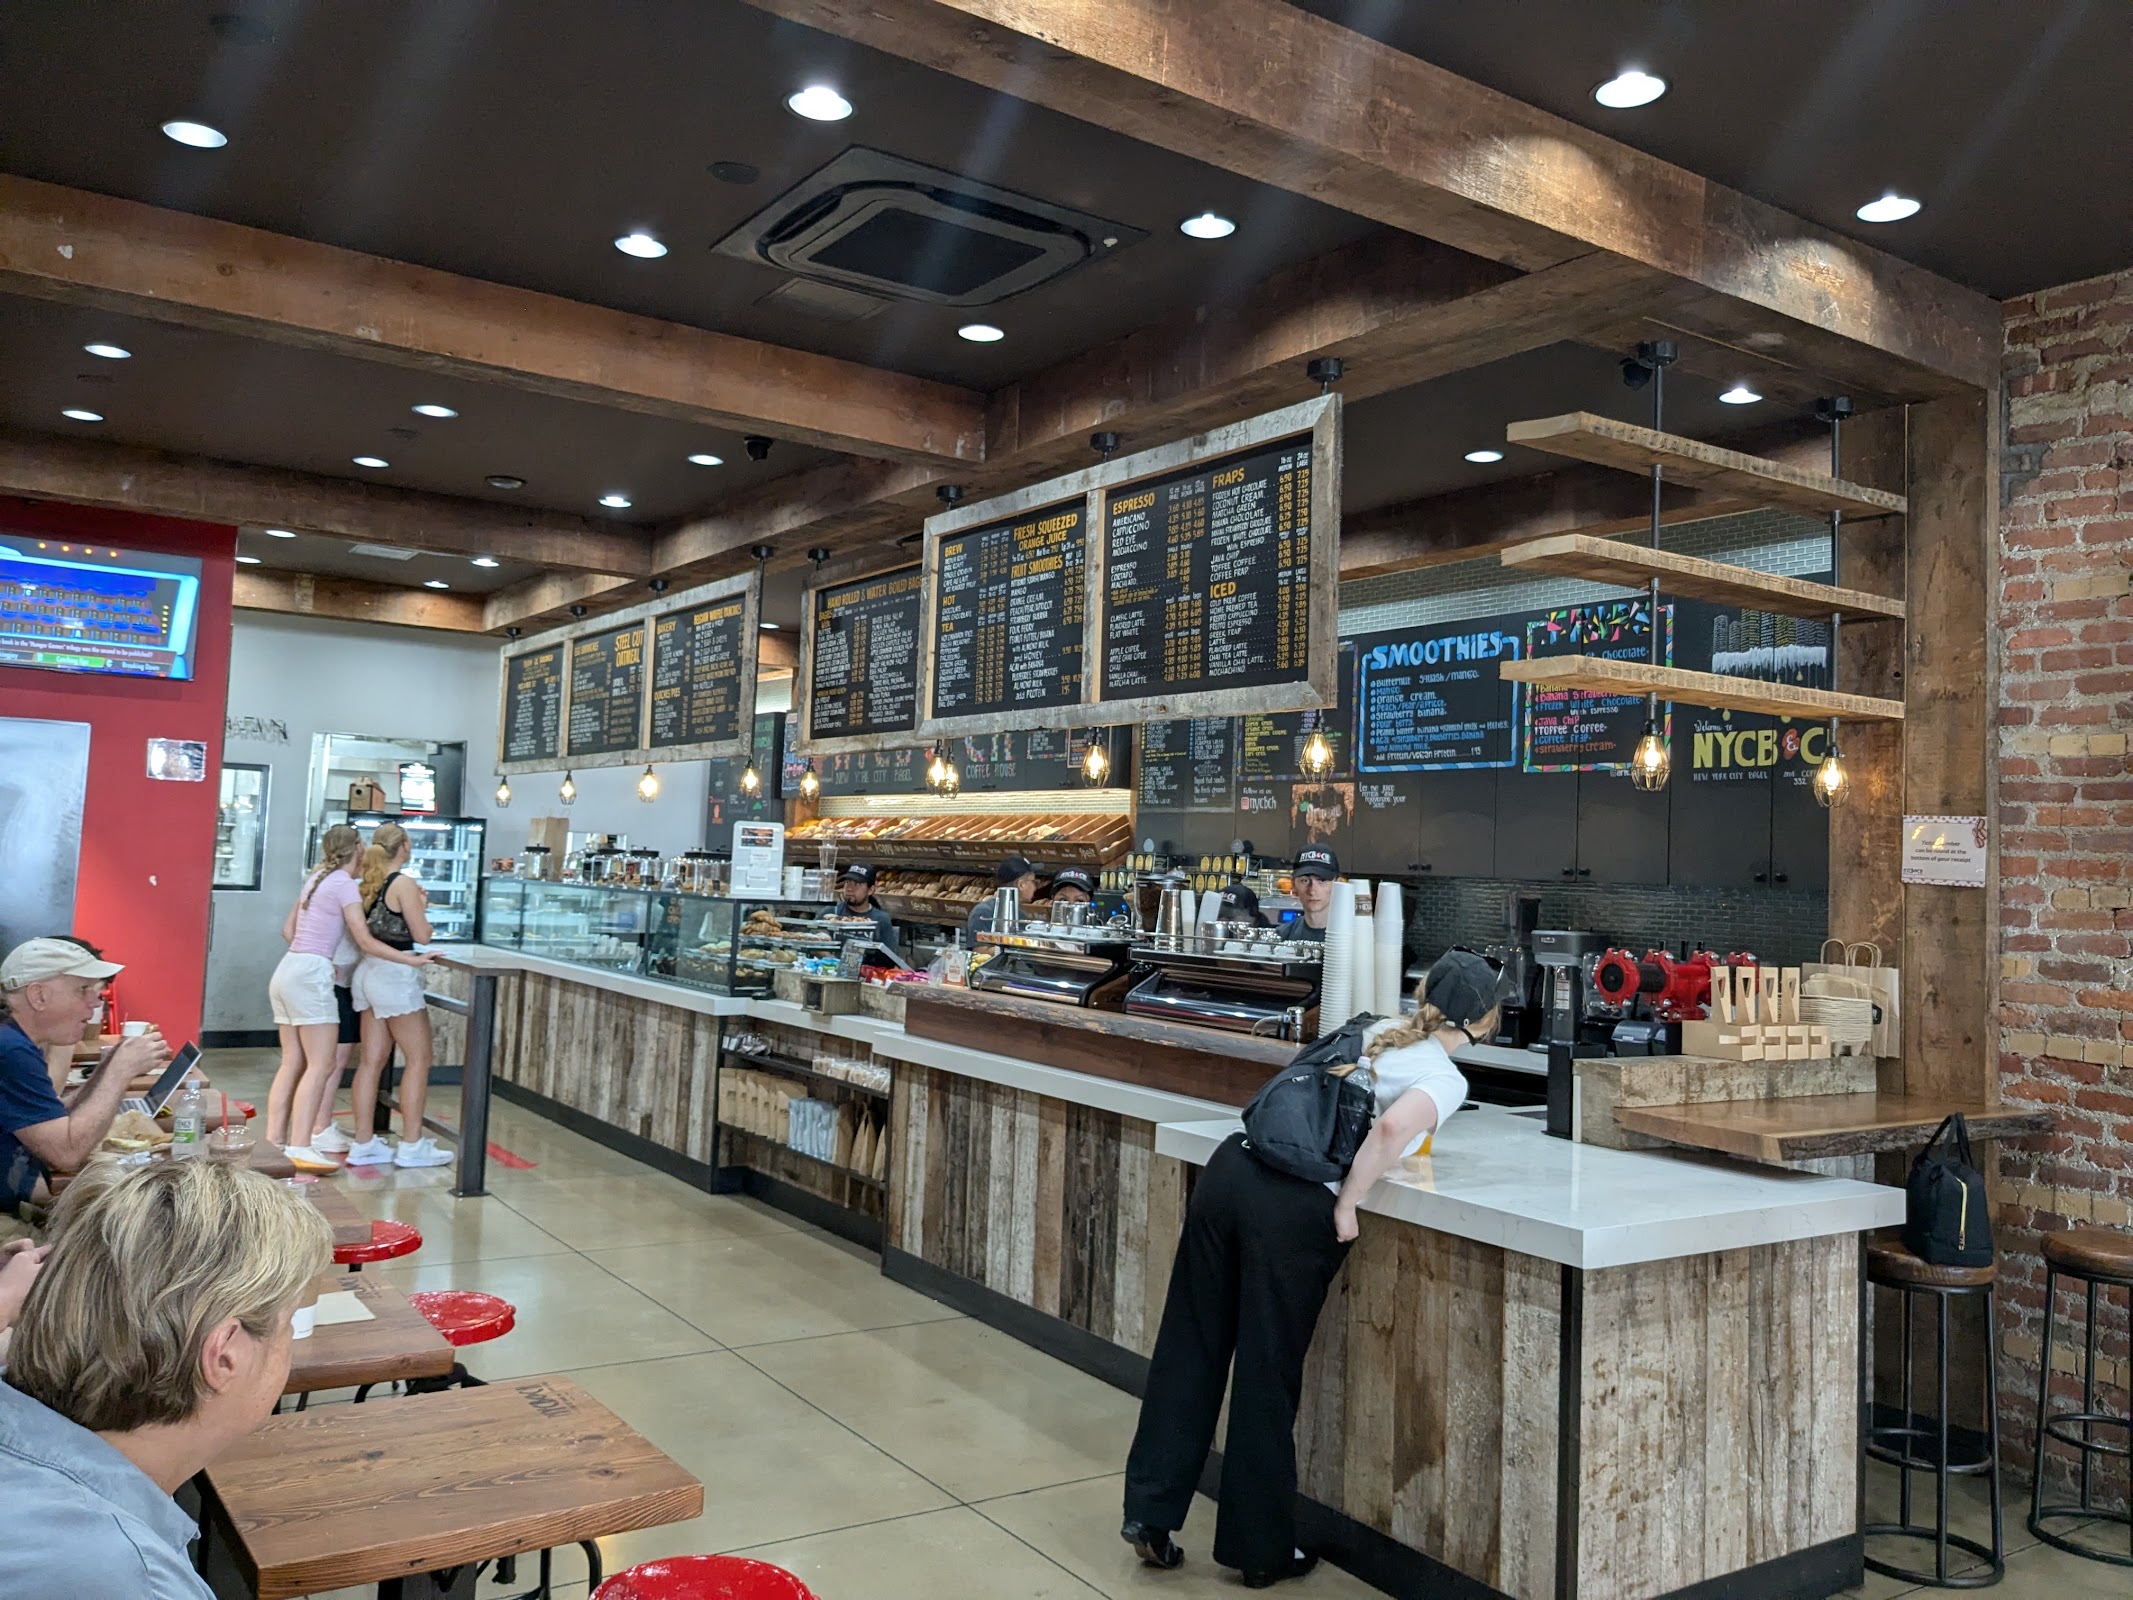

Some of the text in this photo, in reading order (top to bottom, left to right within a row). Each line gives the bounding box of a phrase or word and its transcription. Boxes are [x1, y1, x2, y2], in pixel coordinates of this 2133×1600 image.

[1212, 466, 1245, 489] FRAPS
[1112, 491, 1155, 515] ESPRESSO
[1211, 496, 1238, 511] COCONUT
[1240, 489, 1263, 503] CREAM
[1211, 506, 1234, 519] MATCHA
[1236, 500, 1256, 513] GREEN
[1229, 507, 1264, 524] CHOCOLATE
[1013, 511, 1078, 541] FRESH SQUEEZED
[1112, 510, 1146, 527] AMERICANO
[1112, 519, 1150, 538] CAPPUCCINO
[1018, 535, 1044, 551] ORANGE
[1046, 529, 1067, 544] JUICE
[1111, 533, 1136, 548] RED EYE
[1210, 534, 1230, 546] FROZEN
[944, 542, 963, 557] BREW
[1210, 552, 1224, 564] JAVA
[1225, 549, 1239, 561] CHIP
[1011, 562, 1027, 579] FRUIT
[1028, 553, 1062, 575] SMOOTHIES
[1110, 560, 1137, 574] ESPRESSO
[1210, 560, 1231, 572] TOFFEE
[1232, 555, 1256, 568] COFFEE
[1209, 569, 1232, 582] COFFEE
[1233, 566, 1249, 577] FRAP
[842, 590, 860, 605] ROLLED
[867, 586, 886, 599] WATER
[1209, 580, 1236, 599] ICED
[1237, 591, 1257, 602] COFFEE
[942, 594, 955, 606] HOT
[1209, 600, 1257, 615] HOME BREWED TEA
[1128, 609, 1143, 619] LATTE
[941, 621, 953, 633] TEA
[1131, 617, 1145, 627] LATTE
[1227, 617, 1252, 628] ESPRESSO
[1109, 627, 1139, 639] FLAT WHITE
[1208, 627, 1241, 639] GREEK FRAP
[614, 635, 630, 652] STEEL
[1208, 637, 1225, 646] LATTE
[1232, 642, 1247, 650] LATTE
[1109, 646, 1123, 655] APPLE
[1232, 649, 1247, 658] LATTE
[1370, 631, 1503, 670] SMOOTHIES
[615, 650, 640, 668] OATMEAL
[1208, 655, 1263, 668] VANILLA CHAI LATTE
[1130, 676, 1146, 685] LATTE
[1375, 676, 1410, 688] Butternut
[966, 764, 990, 779] COFFEE
[1693, 773, 1708, 781] NEW
[1712, 772, 1727, 780] YORK
[1729, 771, 1743, 780] CITY
[1748, 771, 1768, 779] BAGEL
